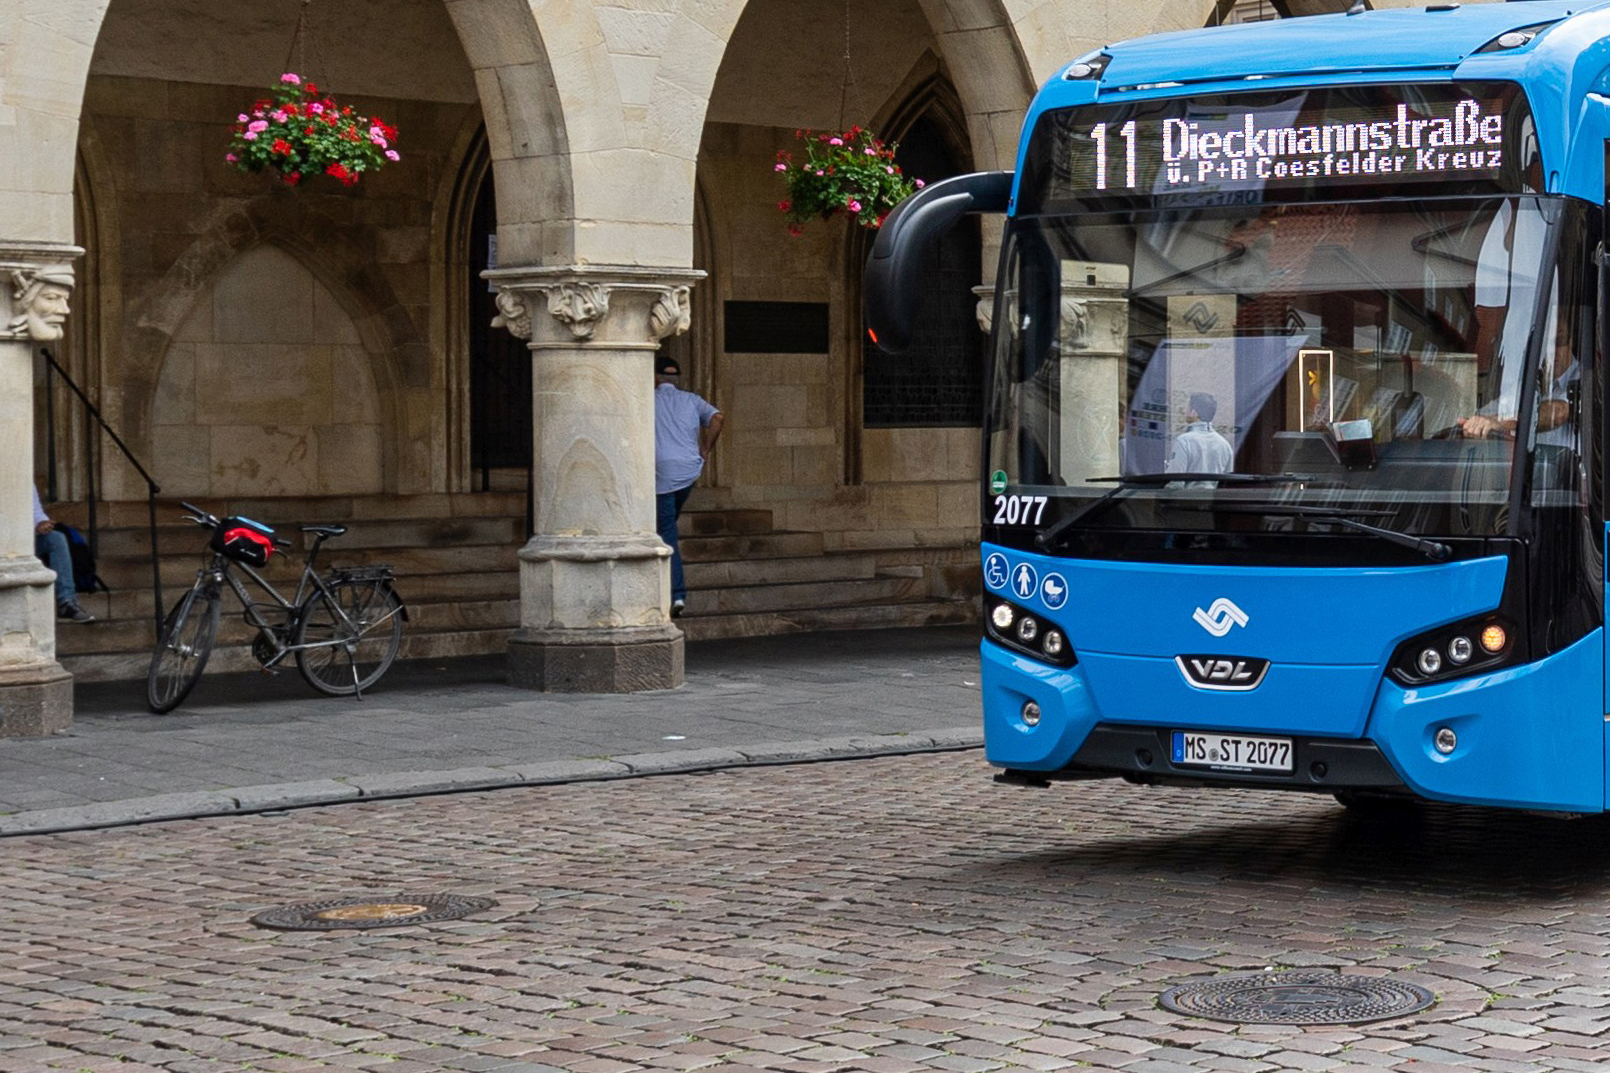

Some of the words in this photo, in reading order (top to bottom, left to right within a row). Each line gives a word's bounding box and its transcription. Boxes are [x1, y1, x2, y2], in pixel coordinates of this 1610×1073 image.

[1090, 120, 1137, 189] 11
[1162, 100, 1502, 161] Dieckmannstraße
[1167, 161, 1190, 184] ü.
[1198, 158, 1248, 182] P+R
[1255, 150, 1407, 180] Coesfelder
[1414, 148, 1502, 172] Kreuz
[993, 494, 1048, 526] 2077
[1190, 659, 1253, 680] VDL
[1185, 736, 1207, 760] MS
[1219, 739, 1242, 763] ST
[1246, 741, 1290, 766] 2077
